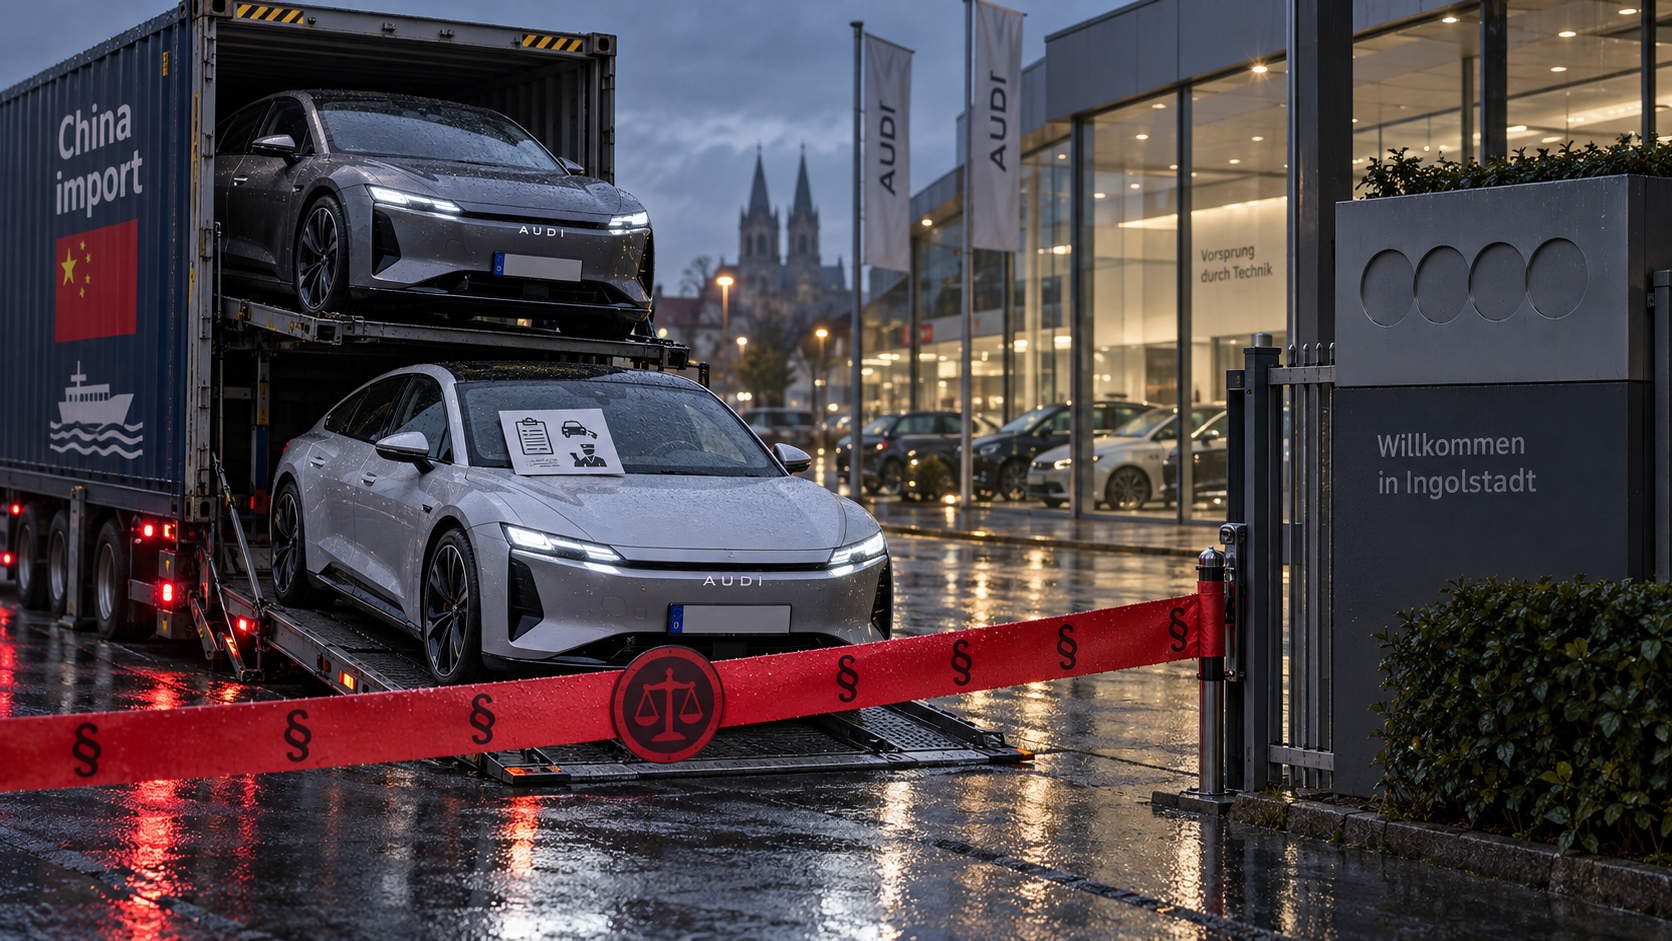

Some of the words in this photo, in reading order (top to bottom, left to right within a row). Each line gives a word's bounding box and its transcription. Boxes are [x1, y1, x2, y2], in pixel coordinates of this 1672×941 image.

[58, 103, 132, 160] China
[990, 70, 1006, 173] AUDI
[879, 99, 896, 197] AUDI
[56, 149, 143, 218] import
[519, 226, 564, 238] AUDI
[1200, 245, 1255, 262] Vorsprung
[1200, 266, 1230, 283] durch
[1232, 262, 1273, 280] Technik
[1377, 432, 1525, 457] Willkommen
[1379, 470, 1398, 494] in
[1407, 467, 1537, 500] Ingolstadt
[702, 575, 763, 587] AUDI
